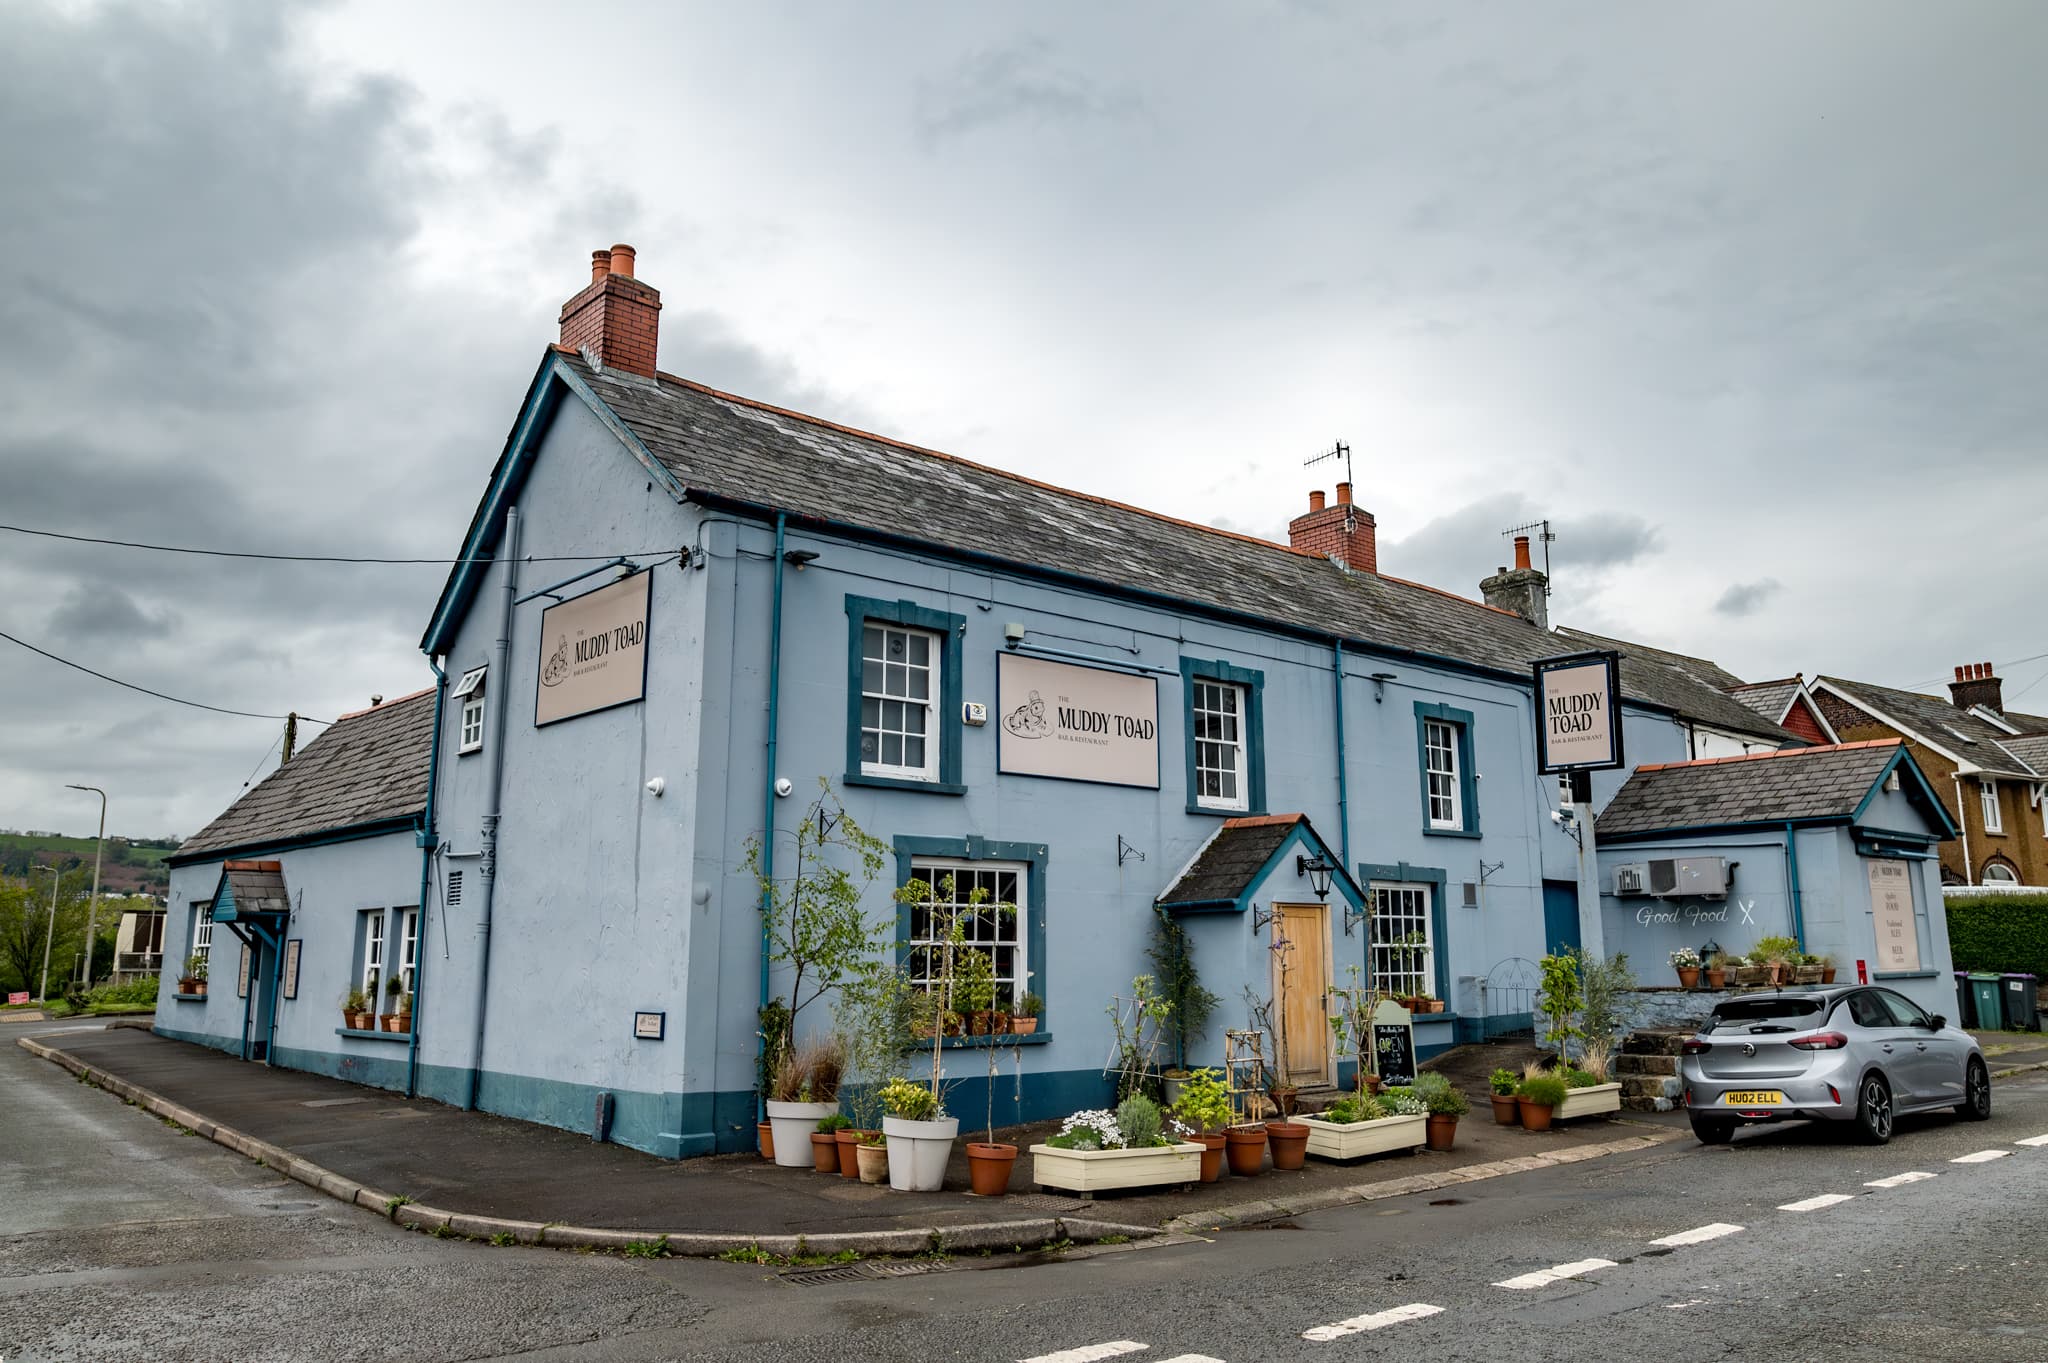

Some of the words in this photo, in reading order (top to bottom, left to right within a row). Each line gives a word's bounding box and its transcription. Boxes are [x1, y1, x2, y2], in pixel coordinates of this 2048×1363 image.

[574, 631, 612, 665] MUDDY
[613, 621, 644, 651] TOAD
[1058, 695, 1069, 703] THE
[1549, 691, 1602, 716] MUDDY
[1058, 706, 1111, 734] MUDDY
[1114, 715, 1154, 740] TOAD
[1549, 712, 1592, 735] TOAD
[1075, 736, 1109, 746] RESTAURANT
[1567, 734, 1603, 743] RESTAURANT
[1636, 906, 1681, 927] Good
[1684, 905, 1729, 927] Food
[1729, 1093, 1755, 1103] HU02
[1757, 1093, 1777, 1103] ELL
